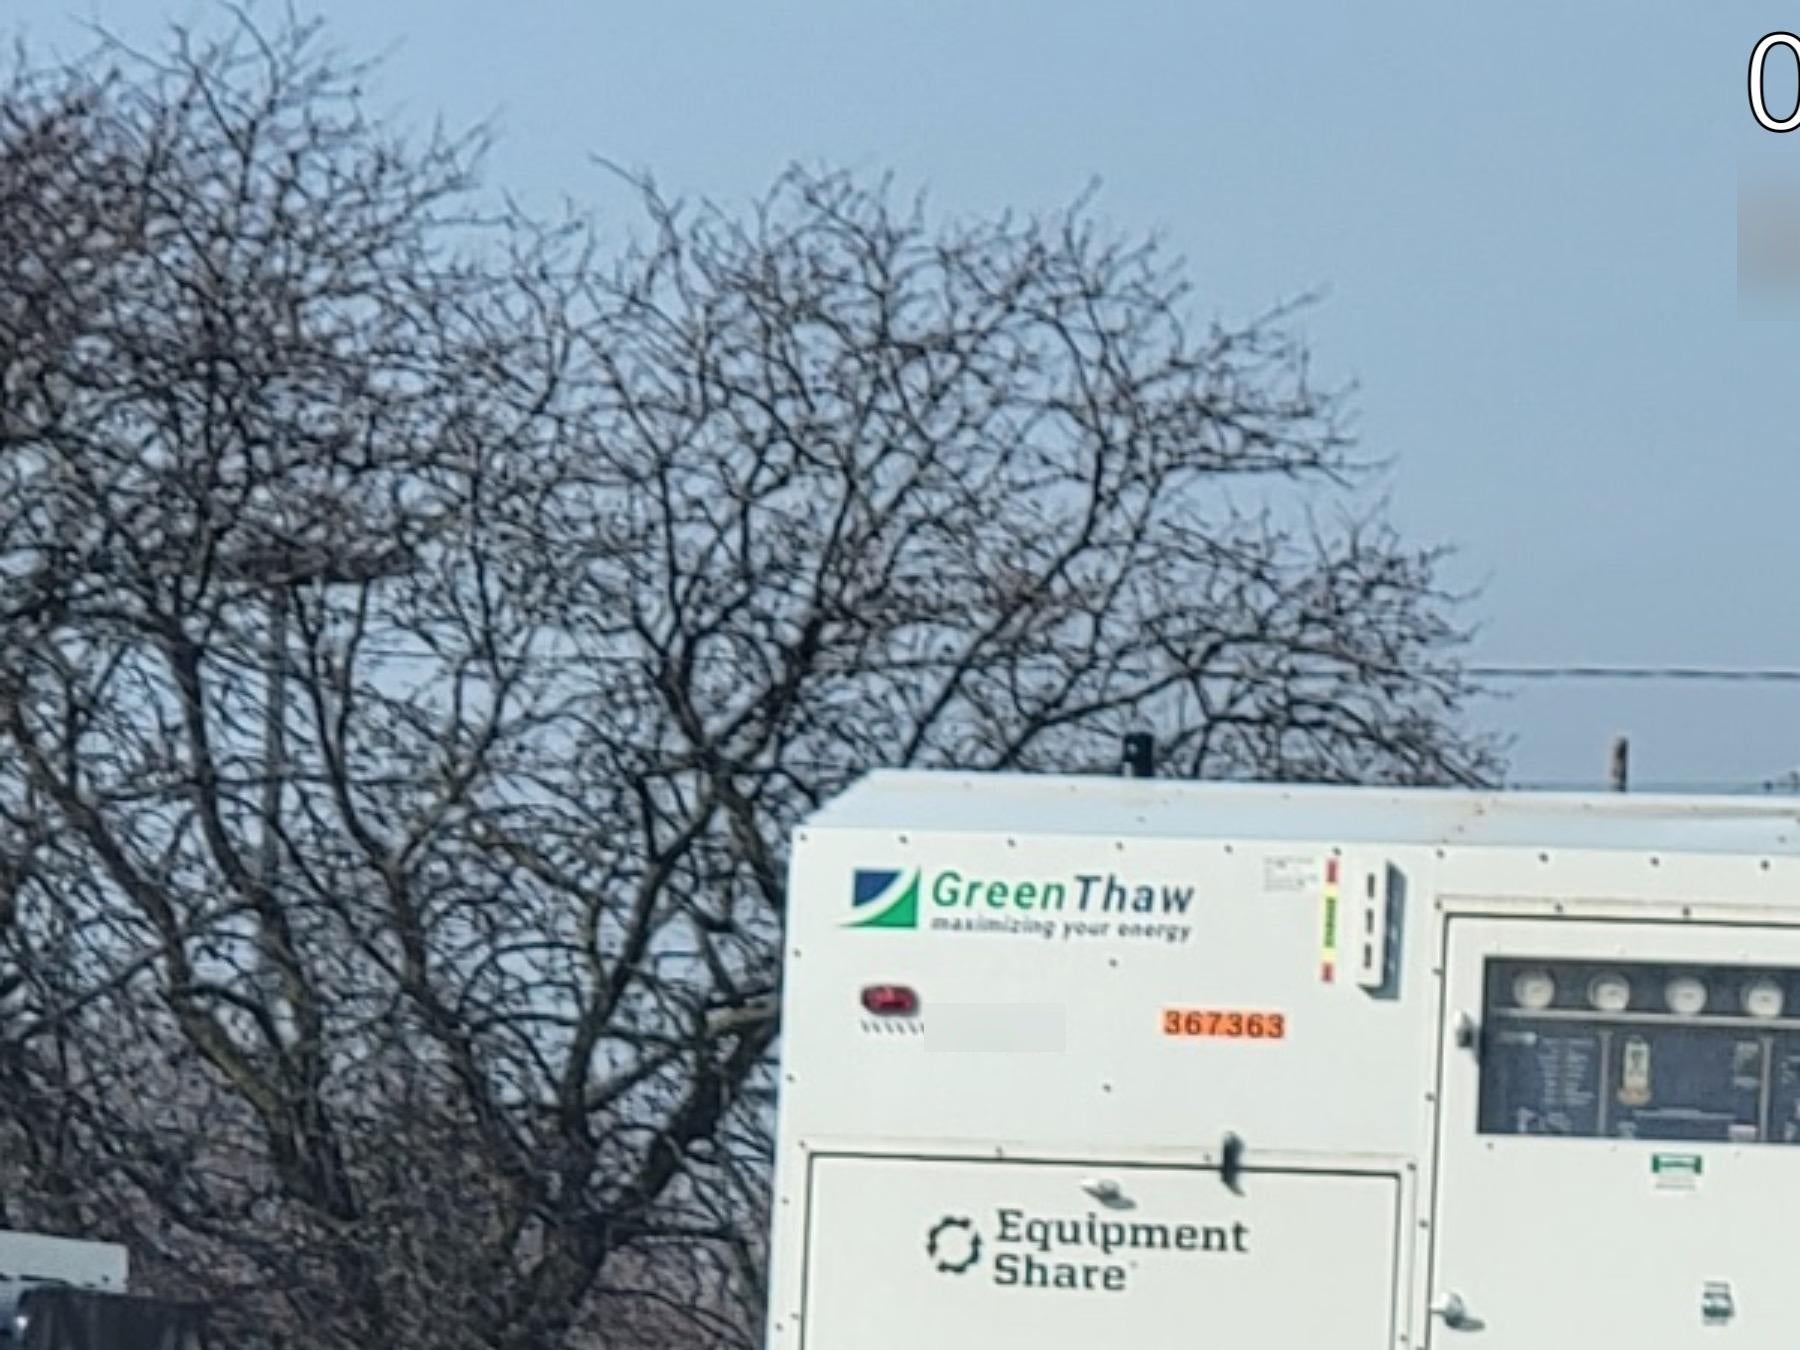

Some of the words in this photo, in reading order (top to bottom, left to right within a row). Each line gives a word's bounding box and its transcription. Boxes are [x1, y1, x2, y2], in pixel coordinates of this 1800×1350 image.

[930, 915, 1056, 939] maximizing
[1062, 921, 1110, 940] your
[1117, 922, 1192, 944] energy
[1163, 1010, 1285, 1039] 367363
[994, 1207, 1250, 1256] Equipment
[993, 1252, 1127, 1292] Share
